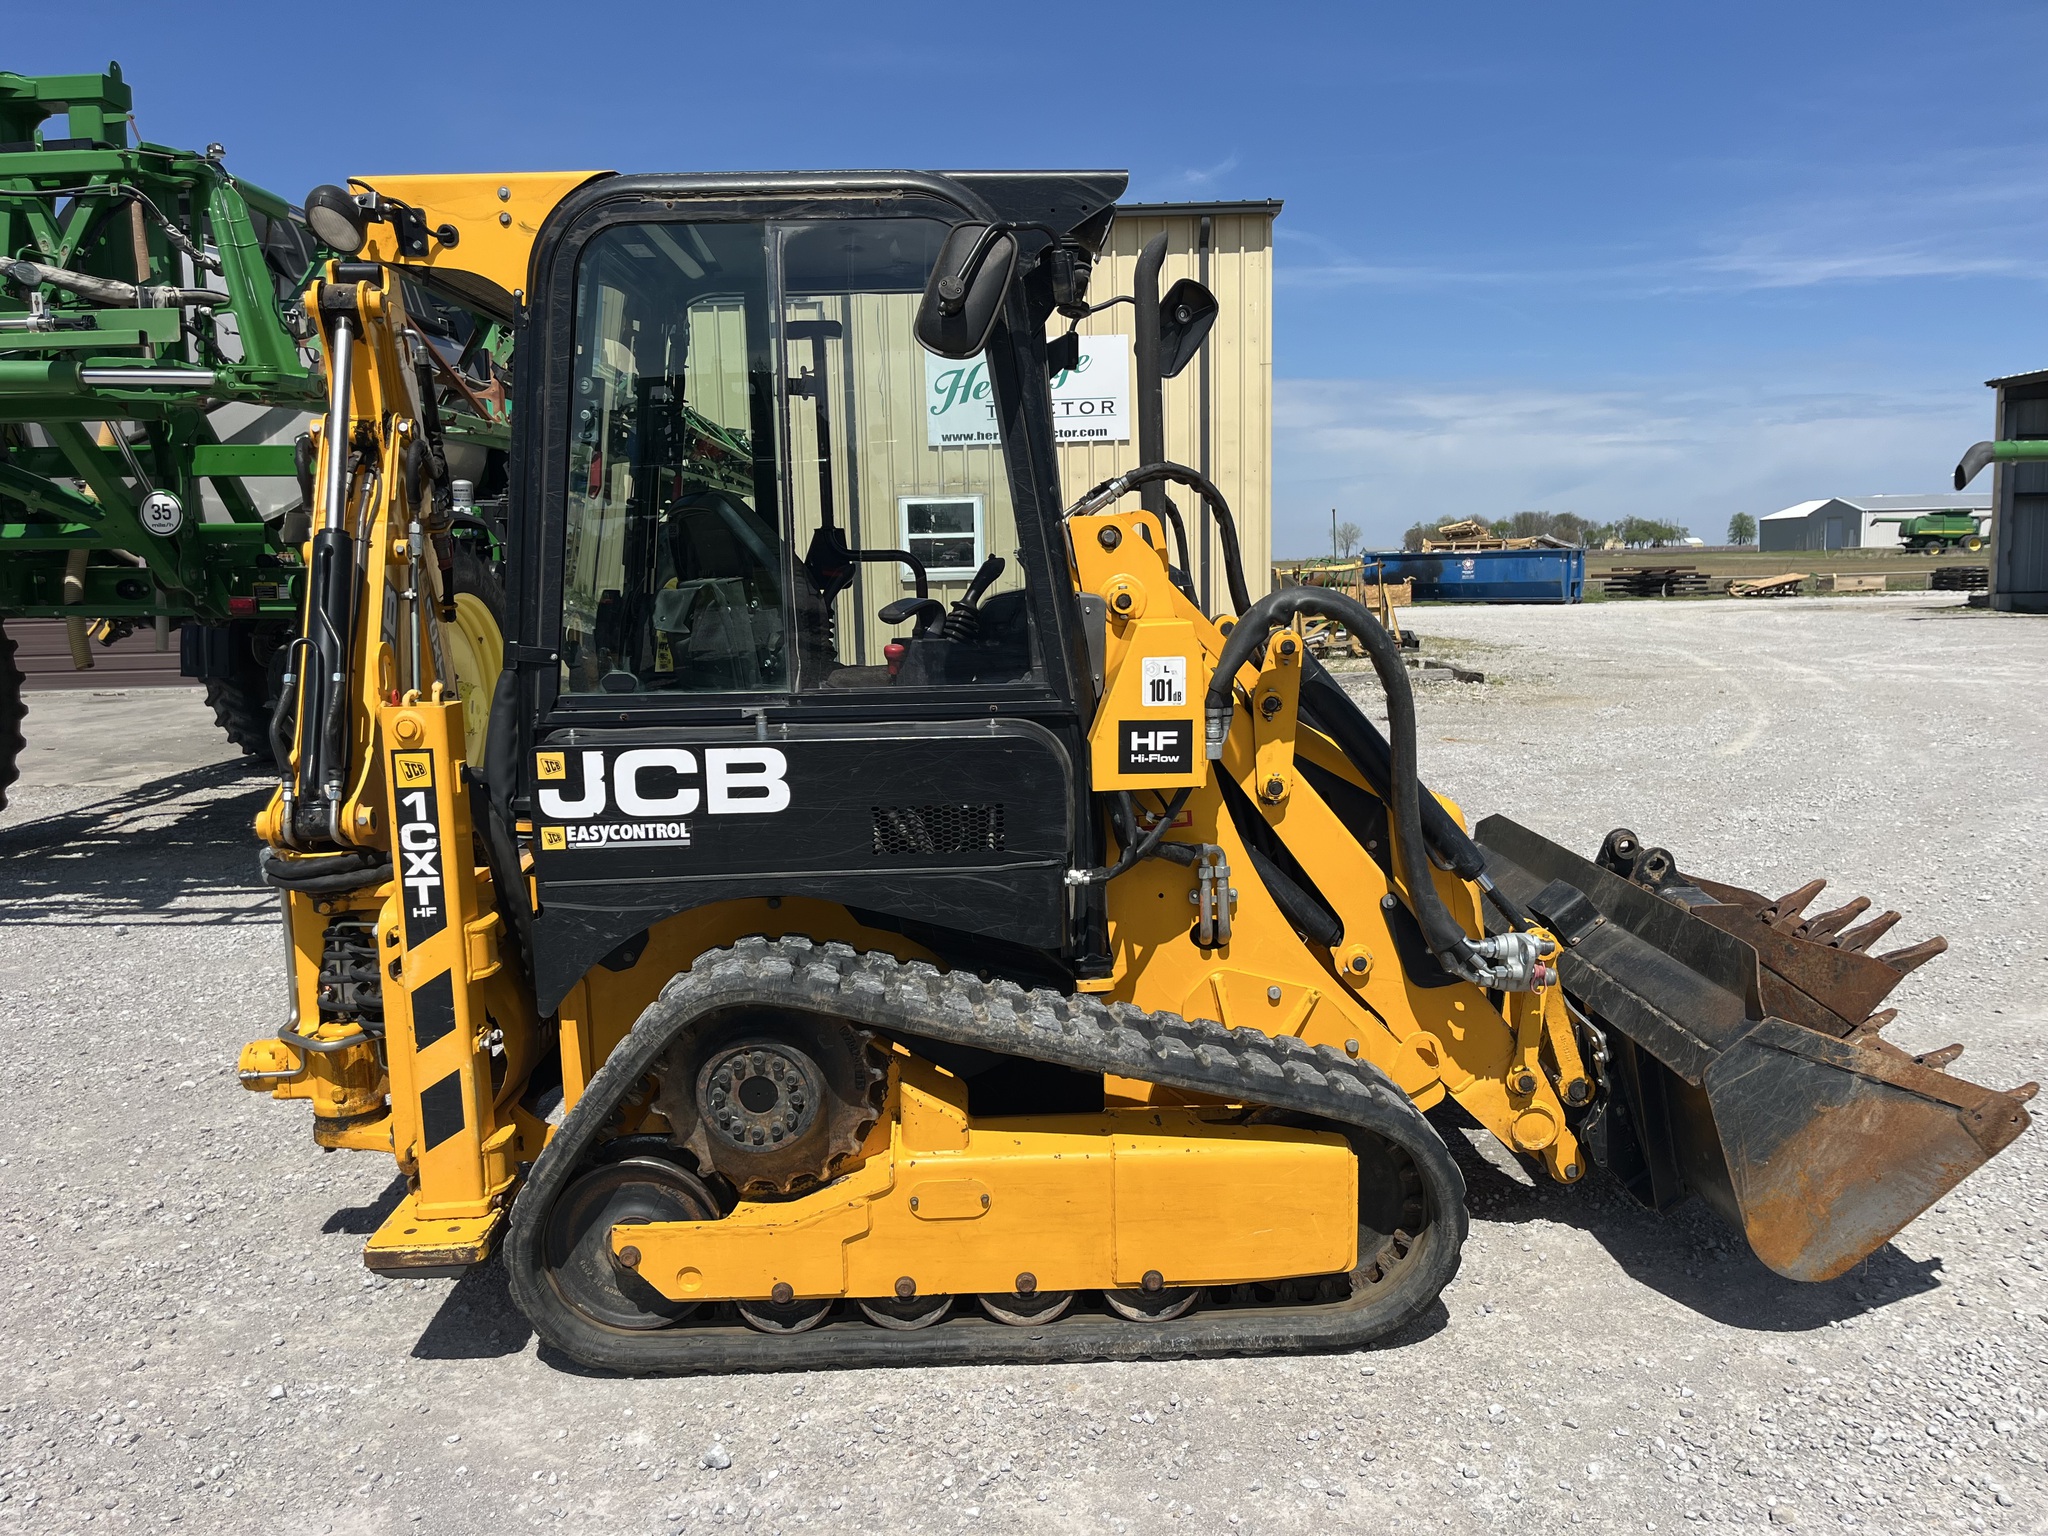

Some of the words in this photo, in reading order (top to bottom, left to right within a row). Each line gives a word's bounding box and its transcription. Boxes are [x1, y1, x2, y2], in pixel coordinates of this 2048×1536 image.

[151, 503, 172, 520] 35
[1163, 665, 1170, 673] L
[1149, 679, 1172, 702] 101
[1173, 691, 1182, 702] dB
[1130, 731, 1178, 751] HF
[544, 760, 562, 773] JCB
[1130, 753, 1180, 763] Hi-Flow
[404, 761, 426, 779] JCB
[538, 747, 791, 819] JCB
[547, 832, 562, 845] JCB
[566, 823, 691, 844] EASYCONTROL
[400, 791, 441, 906] 1CXT
[413, 907, 437, 918] HF
